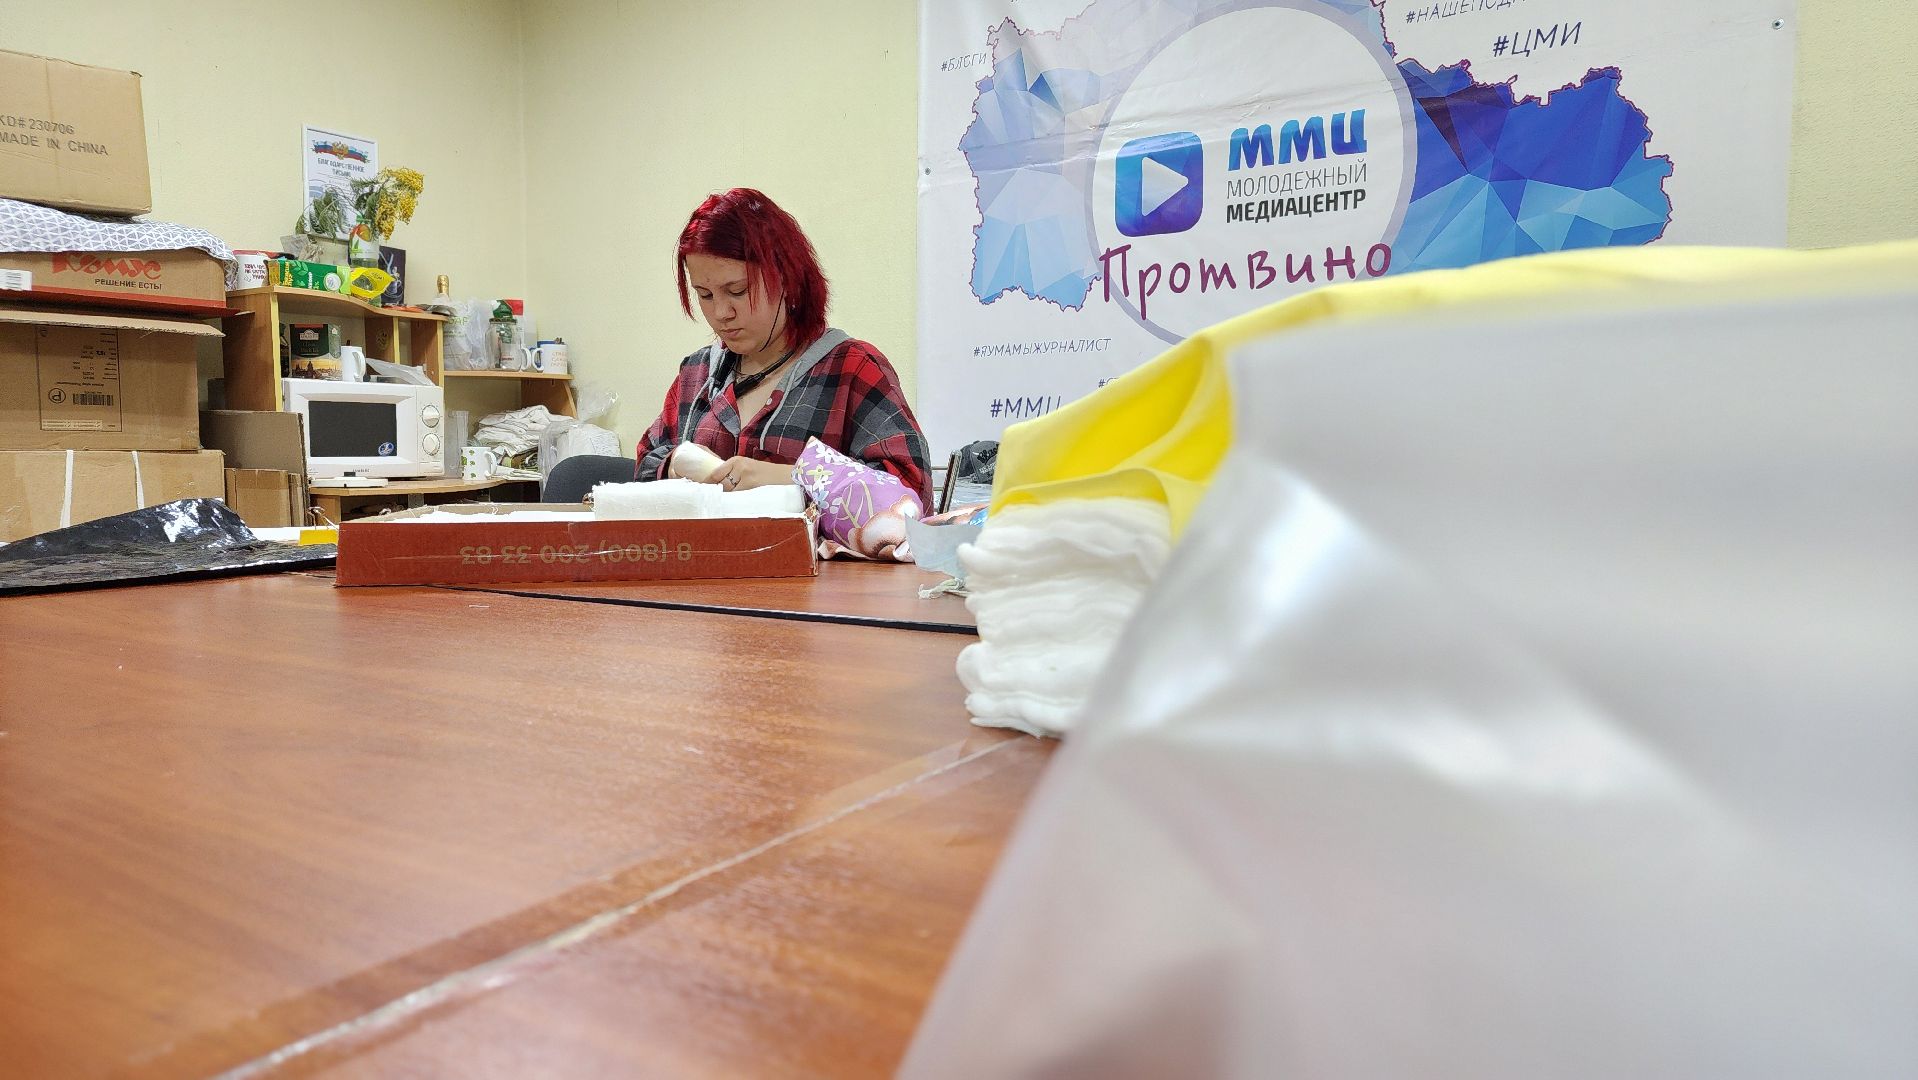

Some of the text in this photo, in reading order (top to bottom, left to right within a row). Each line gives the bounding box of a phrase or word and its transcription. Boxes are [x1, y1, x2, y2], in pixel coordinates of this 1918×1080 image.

[1493, 21, 1582, 57] #ЦМИ
[940, 52, 987, 72] #БЛОГИ
[0, 131, 109, 156] MADE IN CHINA
[1227, 108, 1368, 171] ММЦ
[1226, 157, 1368, 199] МОЛОДЕЖНЫЙ
[1226, 188, 1367, 224] МЕДИАЦЕНТР
[94, 277, 137, 288] РЕШЕНИЕ
[973, 338, 1112, 357] #ЯУМАМЫЖУРНАЛИСТ
[459, 539, 693, 565] 8 (800) 200 33 83
